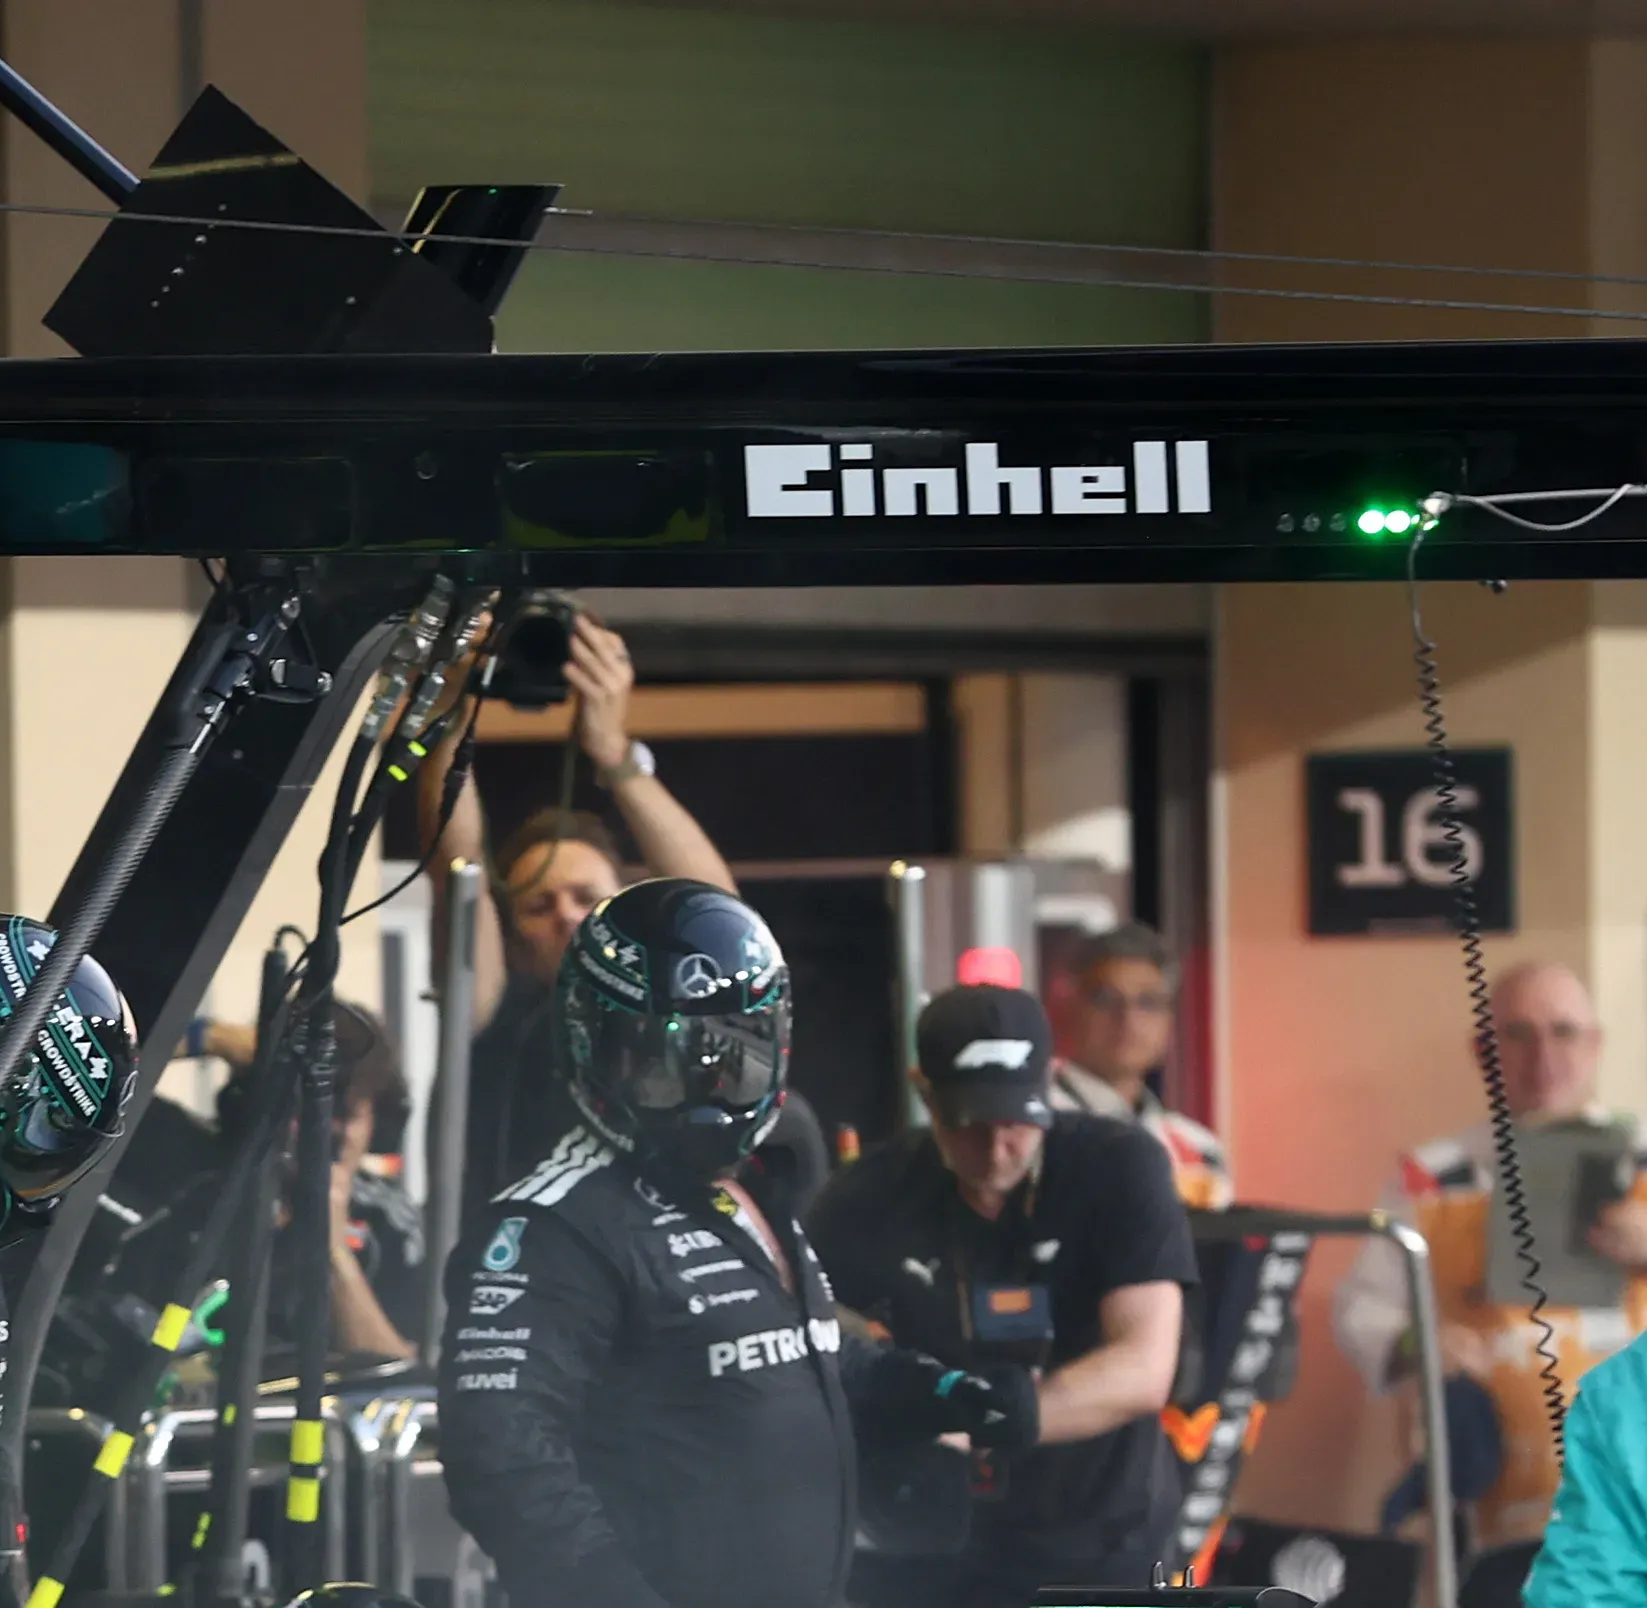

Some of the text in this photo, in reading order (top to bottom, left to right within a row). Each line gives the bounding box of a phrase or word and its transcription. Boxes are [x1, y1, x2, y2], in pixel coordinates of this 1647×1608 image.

[744, 440, 1211, 517] Einhell
[1336, 788, 1483, 888] 16
[36, 1028, 98, 1118] CROWDSTRIKE
